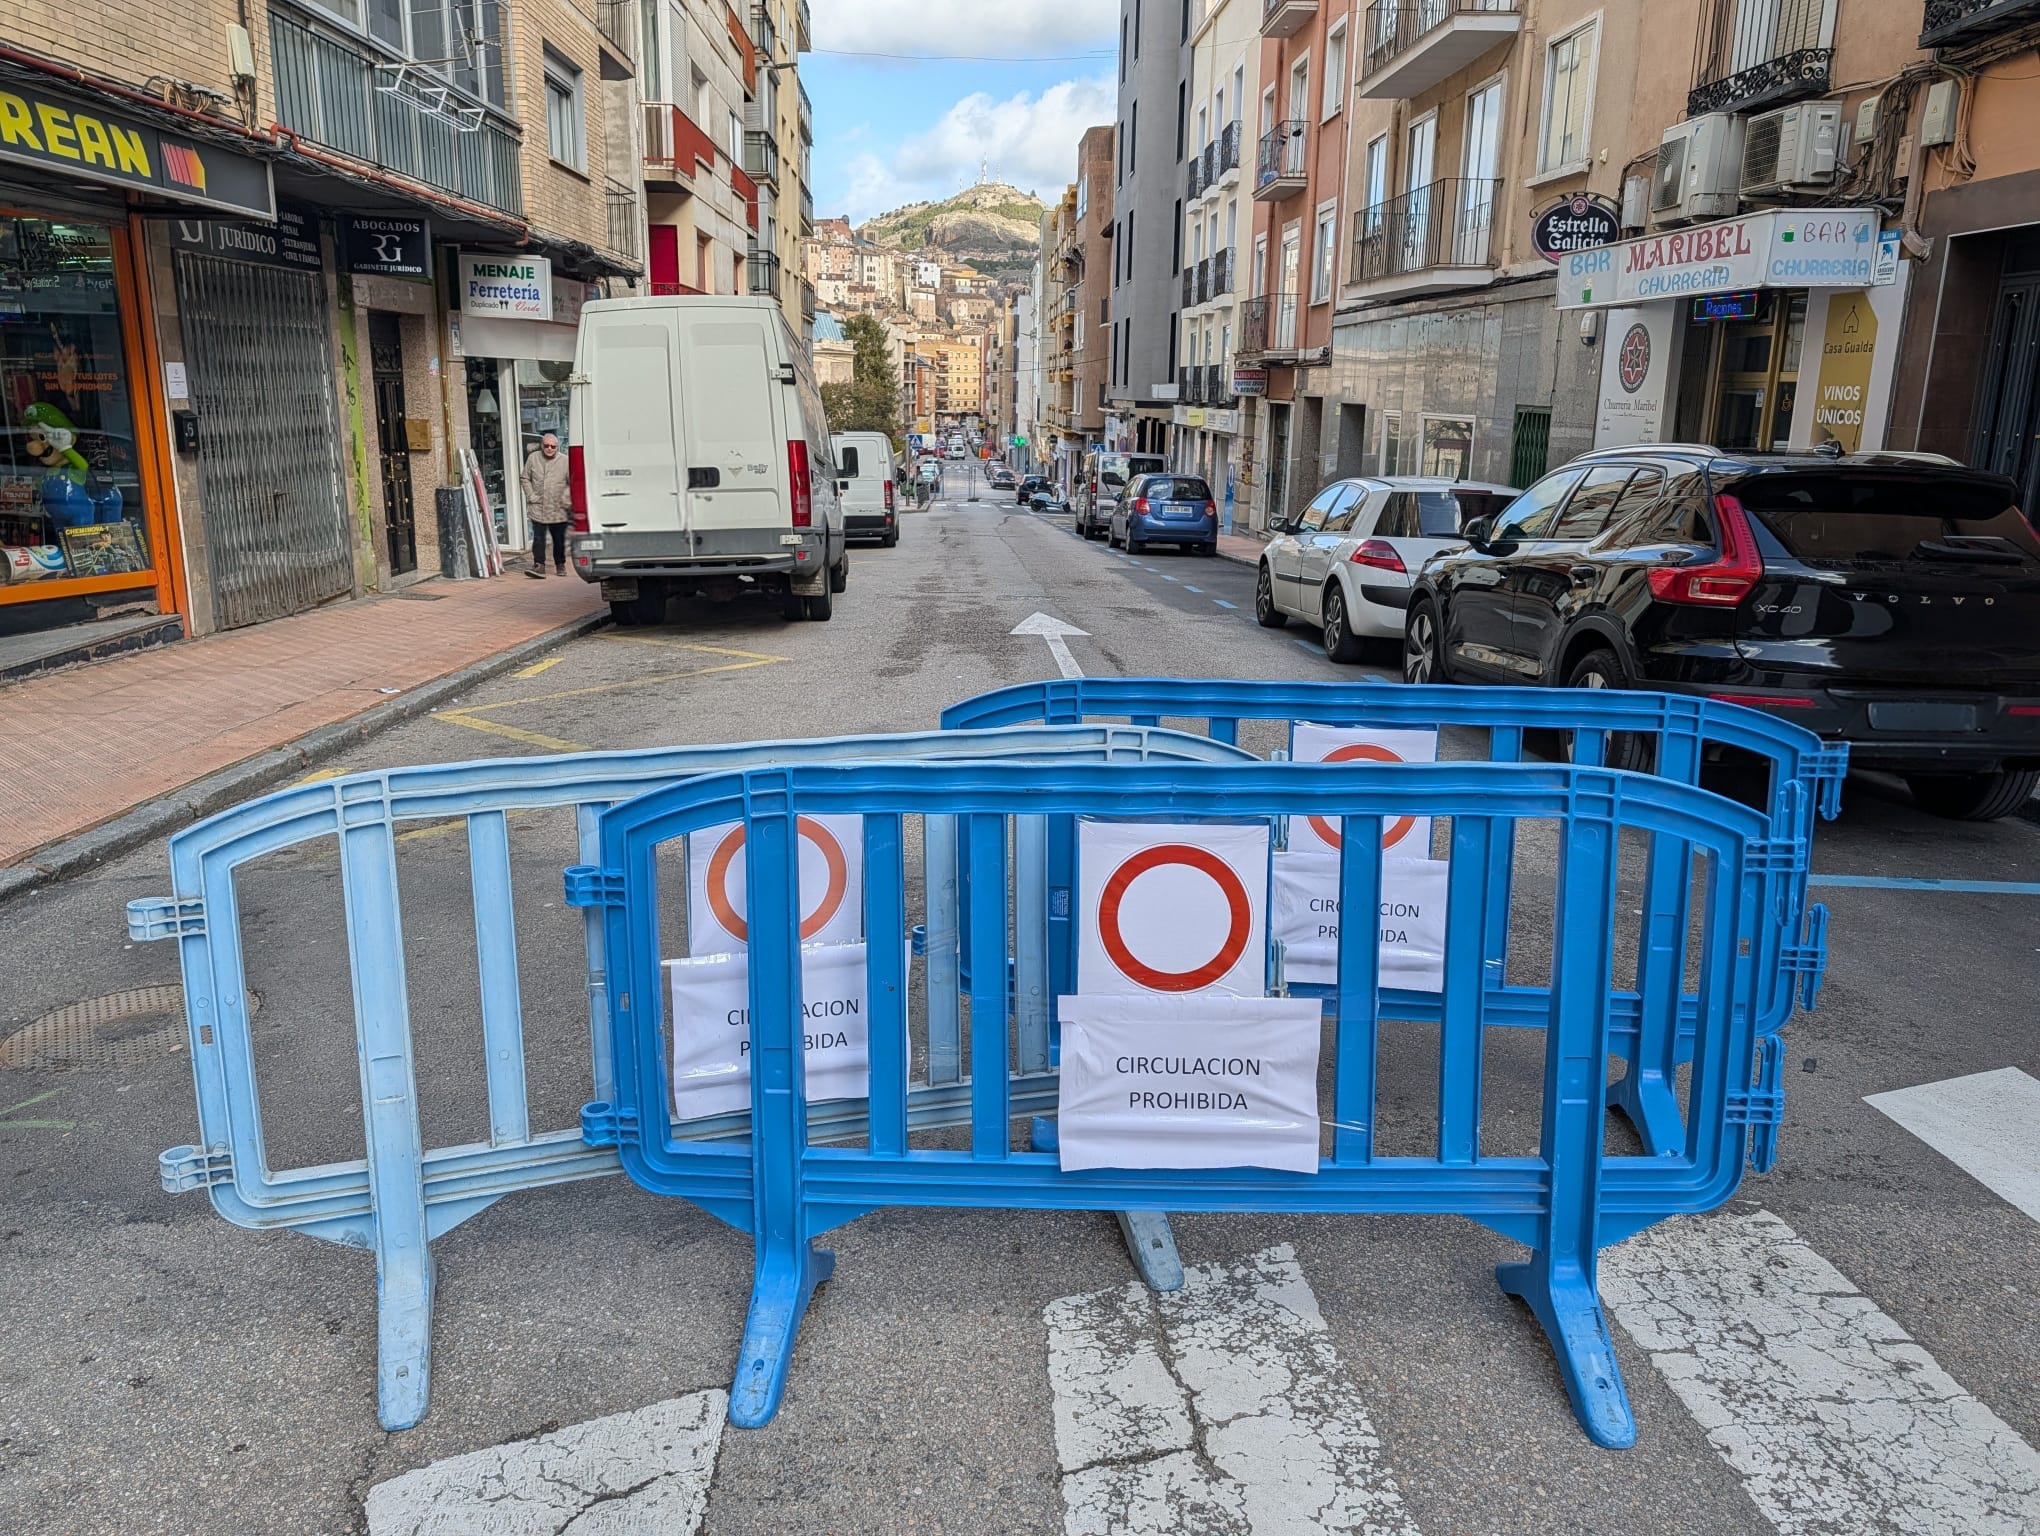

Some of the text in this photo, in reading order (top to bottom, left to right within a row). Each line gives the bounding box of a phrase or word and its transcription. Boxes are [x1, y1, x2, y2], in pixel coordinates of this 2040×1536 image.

[352, 220, 420, 233] ABOGADOS
[1547, 216, 1609, 233] Estrella
[1803, 221, 1847, 243] BAR
[218, 226, 276, 255] JURÍDICO
[1626, 223, 1751, 274] MARIBEL
[354, 262, 422, 273] GABINETE JURÍDICO
[473, 264, 535, 280] MENAJE
[1570, 249, 1611, 277] BAR
[469, 281, 540, 300] Ferretería
[471, 301, 499, 309] Duplicado
[1824, 341, 1874, 354] Casa Gualda
[1824, 385, 1861, 401] VINOS
[1816, 405, 1861, 425] ÚNICOS
[1853, 593, 1995, 606] VOLVO
[1310, 898, 1420, 918] CIRCION
[1318, 925, 1408, 944] PRIDA
[740, 1031, 848, 1057] PBIDA
[1116, 1056, 1261, 1076] CIRCULACION
[1129, 1092, 1249, 1110] PROHIBIDA
